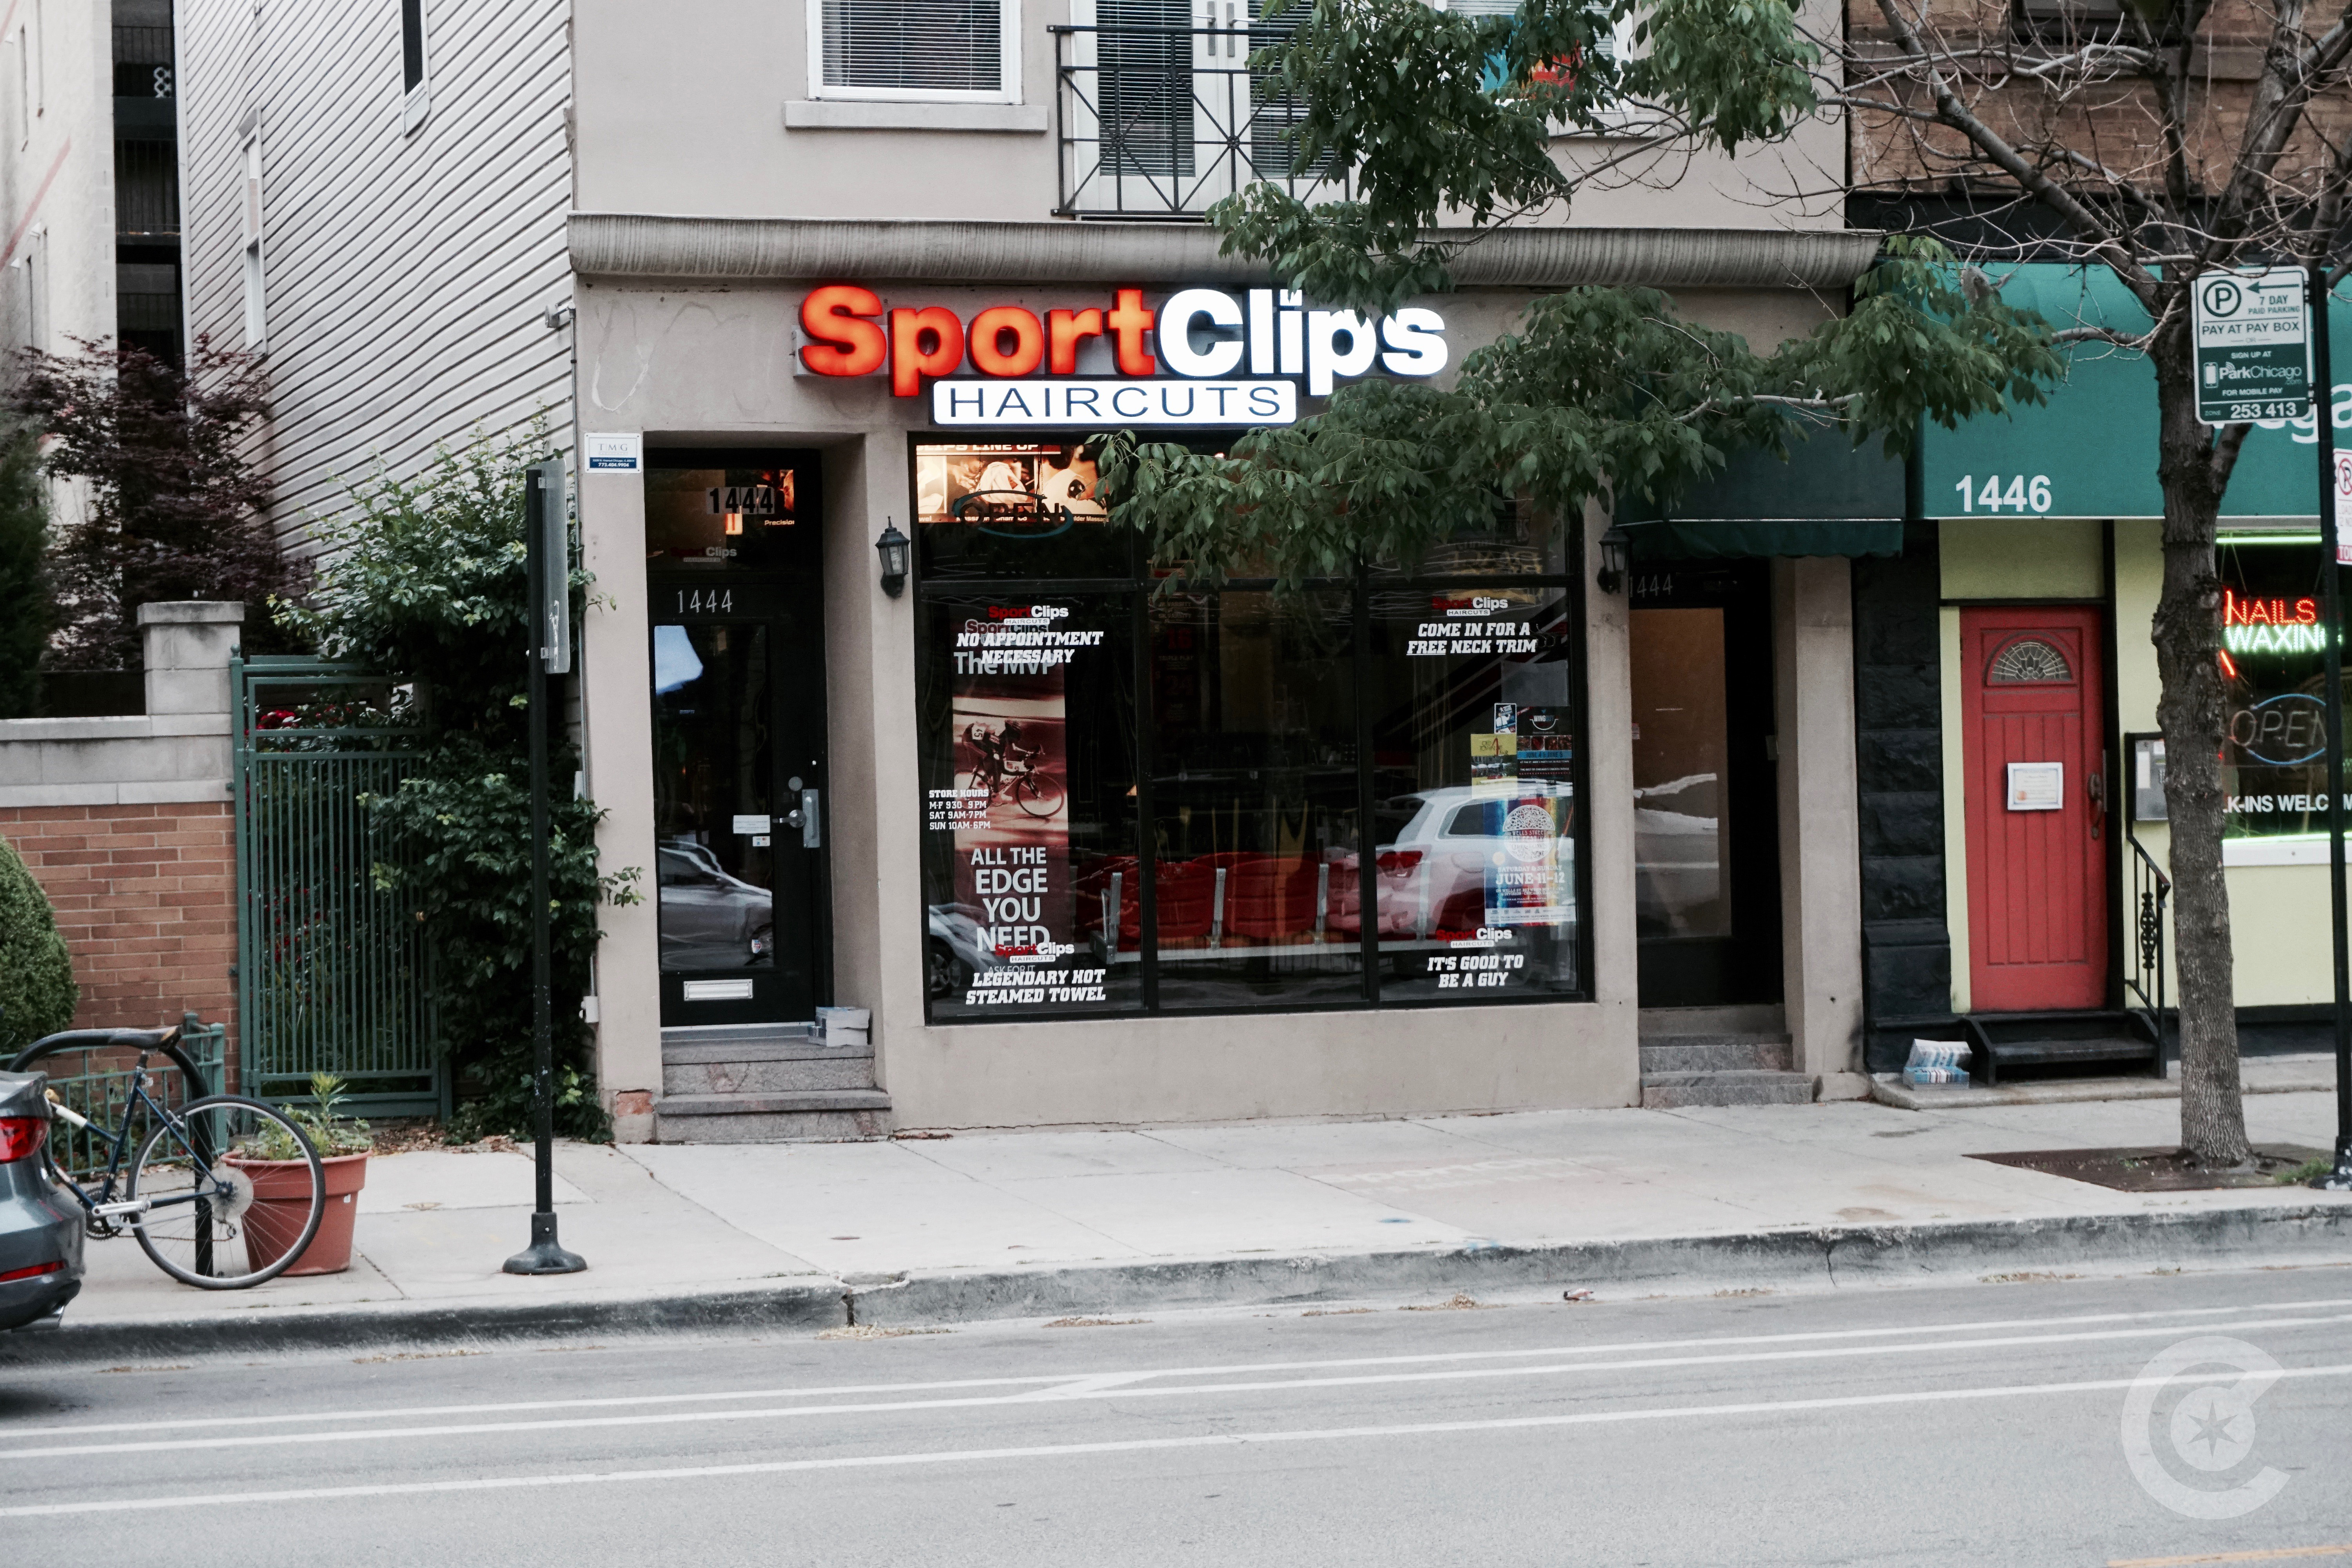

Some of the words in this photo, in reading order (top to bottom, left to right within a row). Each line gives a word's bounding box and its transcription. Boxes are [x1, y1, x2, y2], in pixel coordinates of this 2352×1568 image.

[2259, 297, 2264, 305] 7
[2269, 295, 2288, 305] DAY
[2202, 325, 2225, 335] PAY
[2228, 324, 2242, 333] AT
[2247, 323, 2269, 332] PAY
[2273, 321, 2299, 332] BOX
[2219, 365, 2302, 380] ParkChicago
[951, 387, 1280, 417] HAIRCUTS
[2230, 403, 2261, 419] 253
[2265, 402, 2296, 417] 413
[710, 487, 773, 514] 1444
[1956, 475, 2052, 512] 1446
[678, 590, 733, 613] 1444
[2228, 599, 2317, 624] NAILS
[1418, 623, 1460, 637] COME
[1465, 623, 1484, 636] IN
[1486, 622, 1516, 636] FOR
[1519, 622, 1530, 636] A
[956, 633, 979, 647] NO
[983, 632, 1103, 646] APPOINTMENT
[1407, 640, 1447, 655] FREE
[1451, 640, 1492, 653] NECK
[1495, 639, 1537, 653] TRIM
[981, 649, 1075, 664] NECESSARY
[929, 789, 958, 798] STORE
[960, 789, 989, 797] HOURS
[2223, 795, 2273, 813] K-INS
[948, 811, 987, 819] 9AM-7PM
[929, 822, 946, 830] SUN
[948, 821, 991, 829] 10AM-6PM
[971, 848, 1007, 866] ALL
[1010, 847, 1046, 864] THE
[976, 868, 1048, 894] EDGE
[1496, 873, 1534, 885] JUNE
[982, 897, 1041, 923] YOU
[976, 926, 1050, 951] NEED
[989, 965, 1005, 974] ASK
[1427, 956, 1457, 971] IT'S
[1460, 955, 1499, 970] GOOD
[1503, 955, 1524, 969] TO
[972, 970, 1069, 987] LEGENDARY
[1071, 969, 1106, 984] HOT
[1438, 974, 1458, 988] BE
[1462, 973, 1473, 987] A
[1477, 972, 1508, 986] GUY
[965, 988, 1044, 1005] STEAMED
[1049, 986, 1106, 1002] TOWEL
